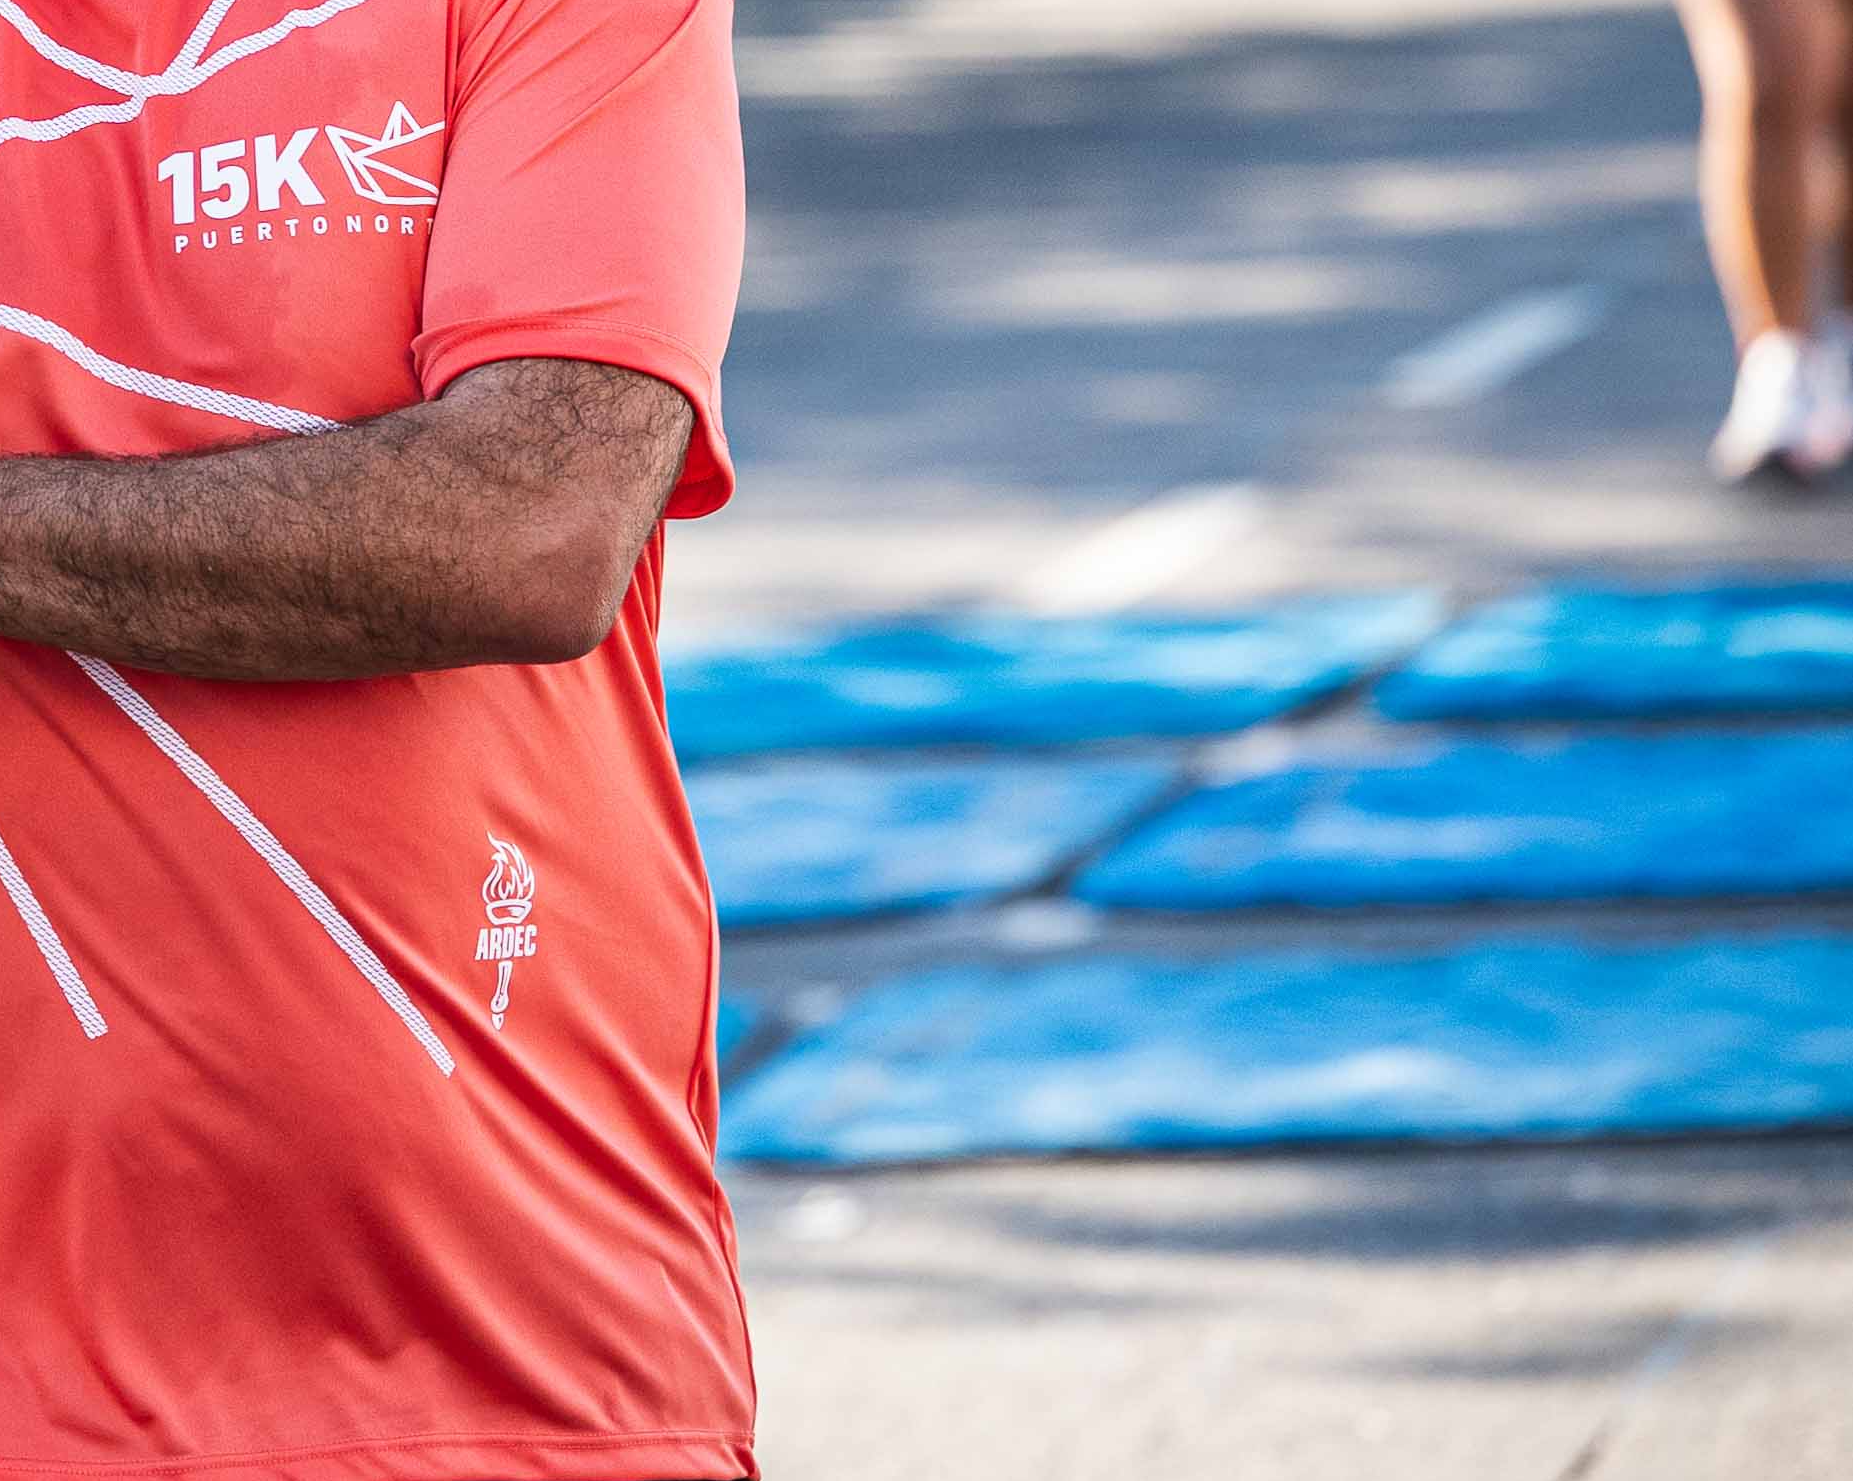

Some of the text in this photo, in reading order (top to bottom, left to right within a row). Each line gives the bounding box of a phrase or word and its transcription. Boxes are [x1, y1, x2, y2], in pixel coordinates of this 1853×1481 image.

[156, 126, 327, 226] 15K
[173, 213, 434, 254] PUERTO NORT
[474, 923, 538, 961] ARDEC
